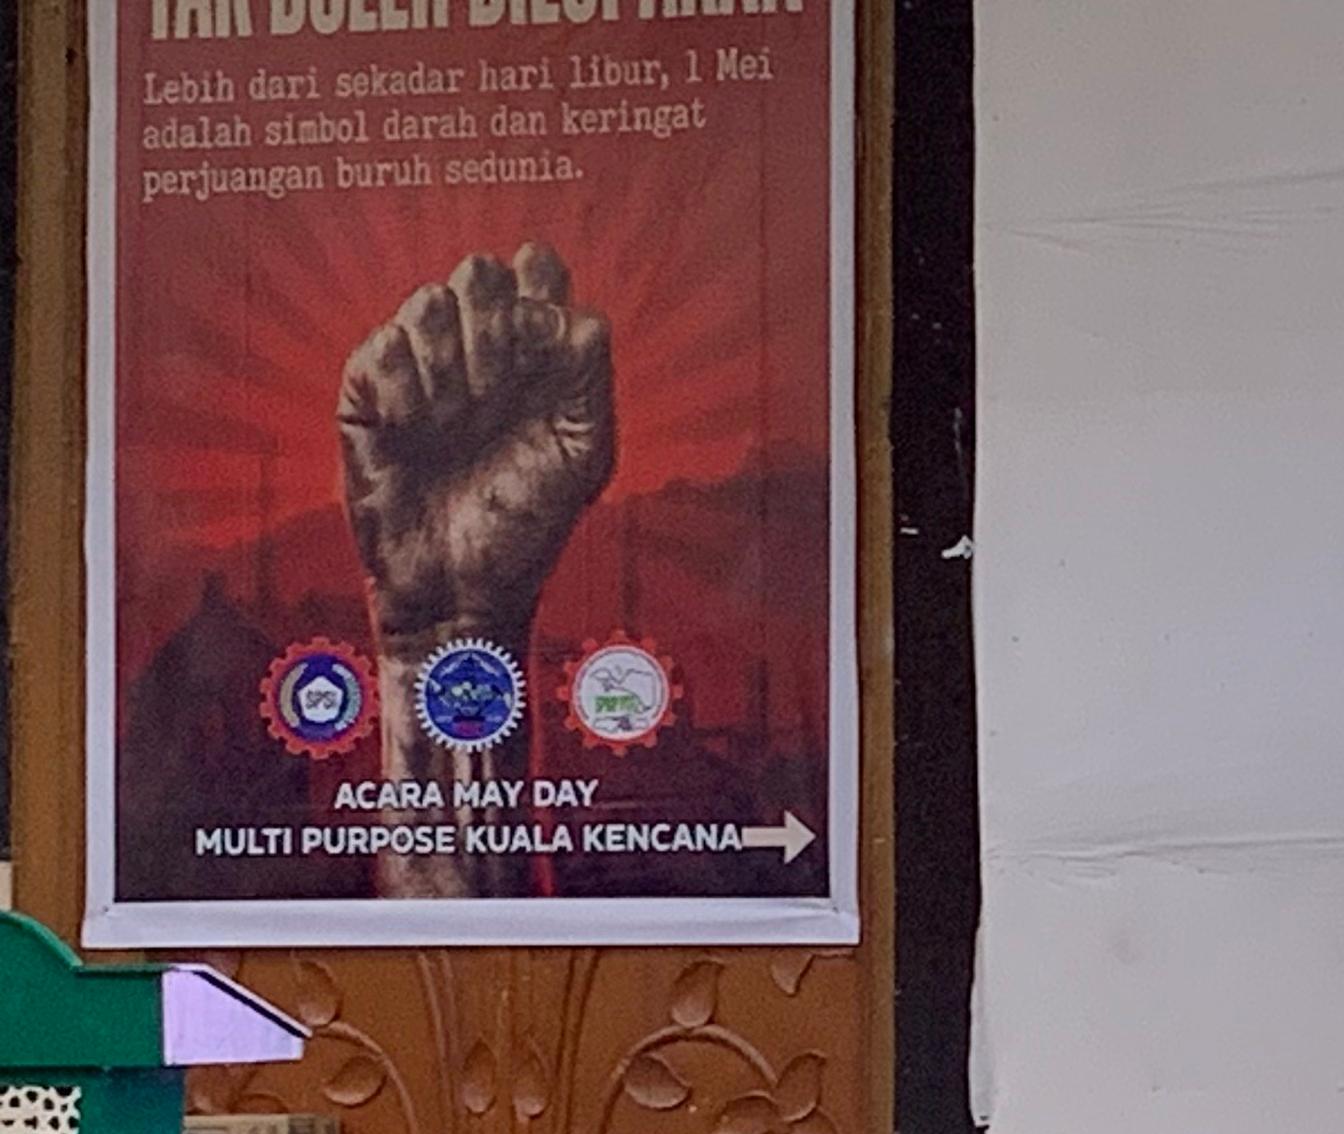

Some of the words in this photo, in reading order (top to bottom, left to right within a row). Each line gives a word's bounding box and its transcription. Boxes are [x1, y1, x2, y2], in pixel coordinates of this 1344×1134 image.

[143, 70, 235, 105] Lebih
[249, 66, 321, 100] dari
[335, 62, 465, 98] sekadar
[478, 57, 554, 92] hari
[570, 54, 669, 90] libur,
[686, 50, 702, 82] 1
[716, 47, 774, 81] Mei
[143, 114, 251, 150] adalah
[265, 110, 369, 146] simbol
[383, 107, 477, 140] darah
[490, 105, 547, 137] dan
[562, 97, 707, 139] keringat
[143, 160, 325, 203] perjuangan
[337, 154, 432, 189] buruh
[444, 150, 584, 184] sedunia.
[333, 780, 445, 810] ACARA
[453, 779, 525, 809] MAY
[533, 778, 600, 808] DAY
[195, 827, 293, 856] MULTI
[301, 825, 456, 855] PURPOSE
[466, 824, 574, 853] KUALA
[582, 822, 743, 853] KENCANA
